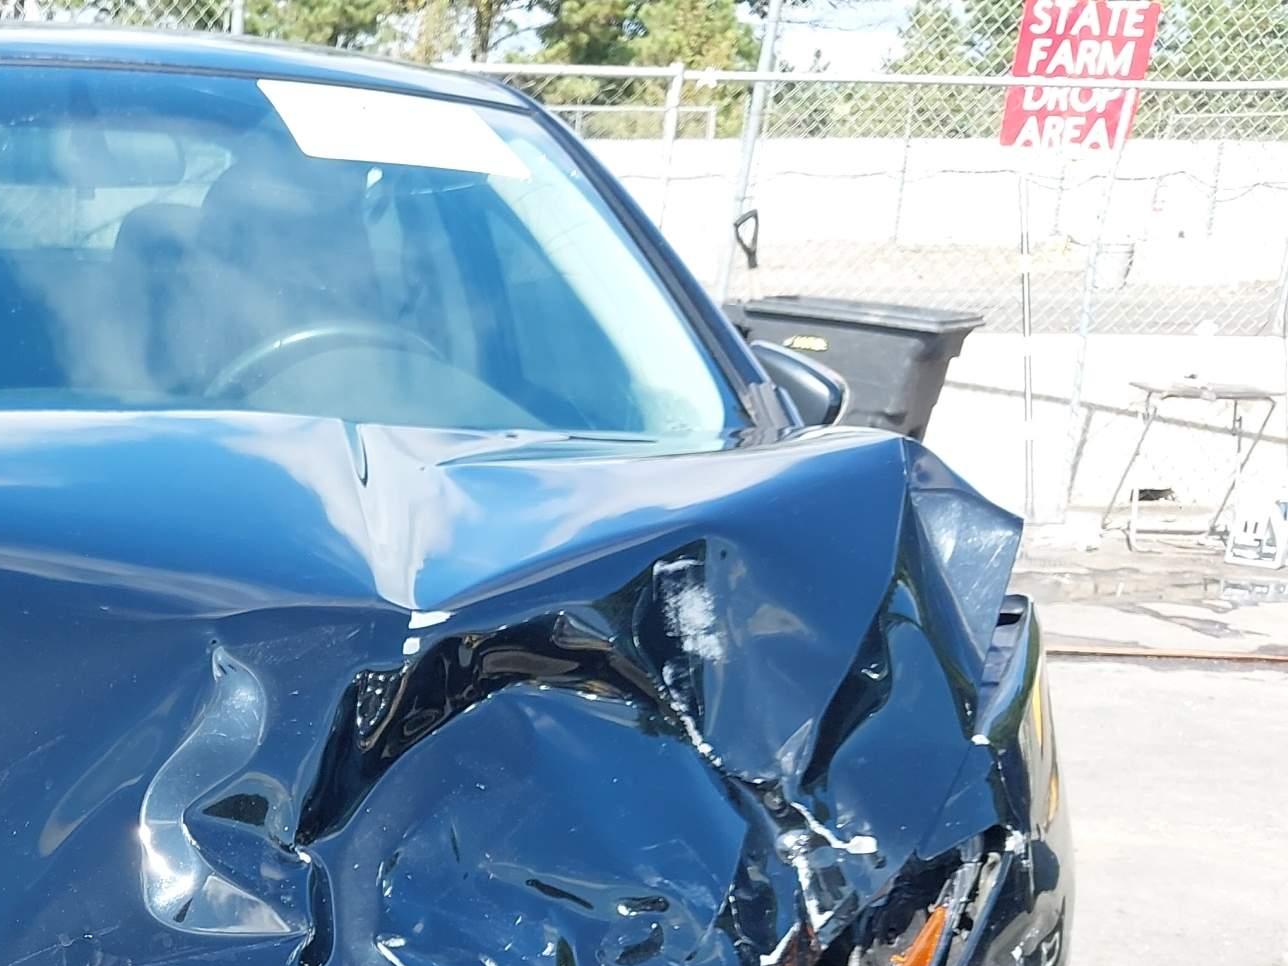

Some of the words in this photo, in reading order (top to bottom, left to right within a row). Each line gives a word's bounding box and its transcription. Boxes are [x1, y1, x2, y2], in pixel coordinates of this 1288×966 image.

[1029, 0, 1151, 37] STATE
[1027, 38, 1136, 77] FARM
[1021, 82, 1124, 113] DROP
[1014, 115, 1114, 150] AREA
